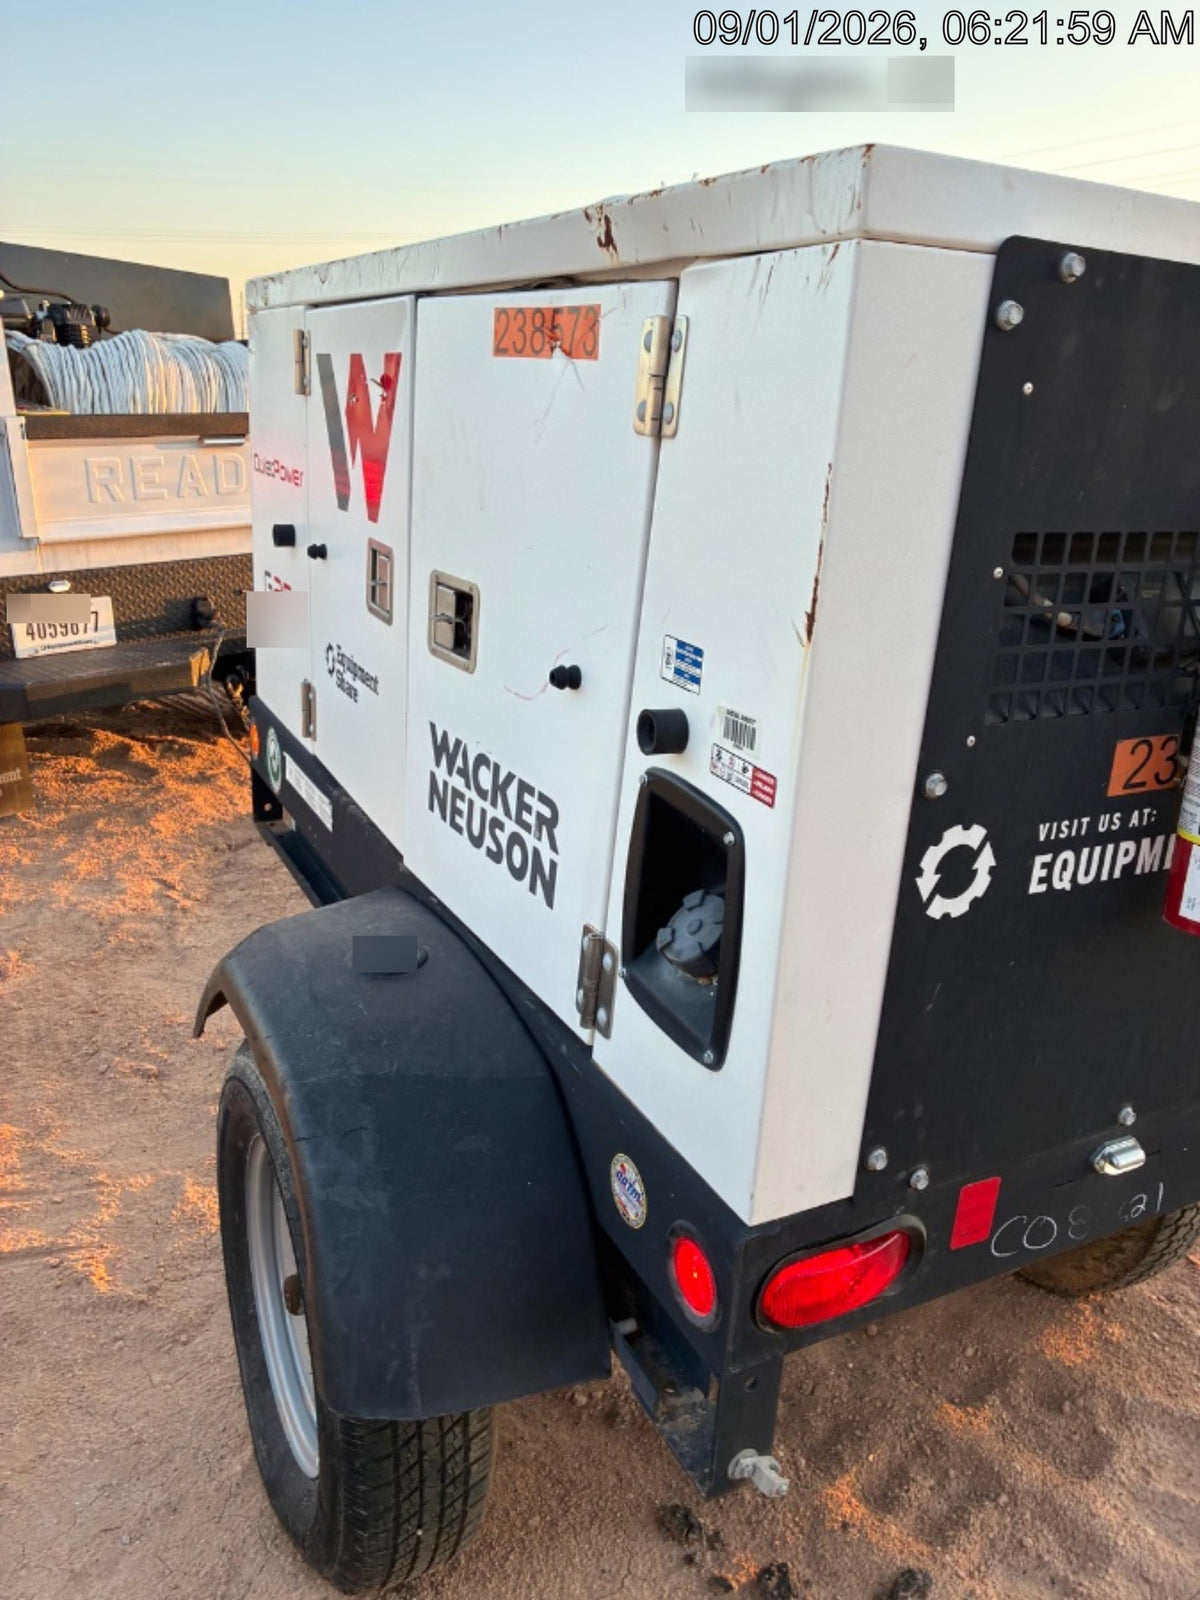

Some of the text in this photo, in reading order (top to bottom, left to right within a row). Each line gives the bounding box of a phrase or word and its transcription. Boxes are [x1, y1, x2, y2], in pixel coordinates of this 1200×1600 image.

[495, 305, 598, 357] 238573
[84, 452, 247, 504] READ
[336, 643, 379, 696] Equipment
[336, 668, 358, 703] Share
[0, 767, 23, 785] ent
[429, 720, 559, 856] WACKER
[428, 768, 558, 911] NEUSON
[1038, 807, 1157, 842] VISIT US AT:
